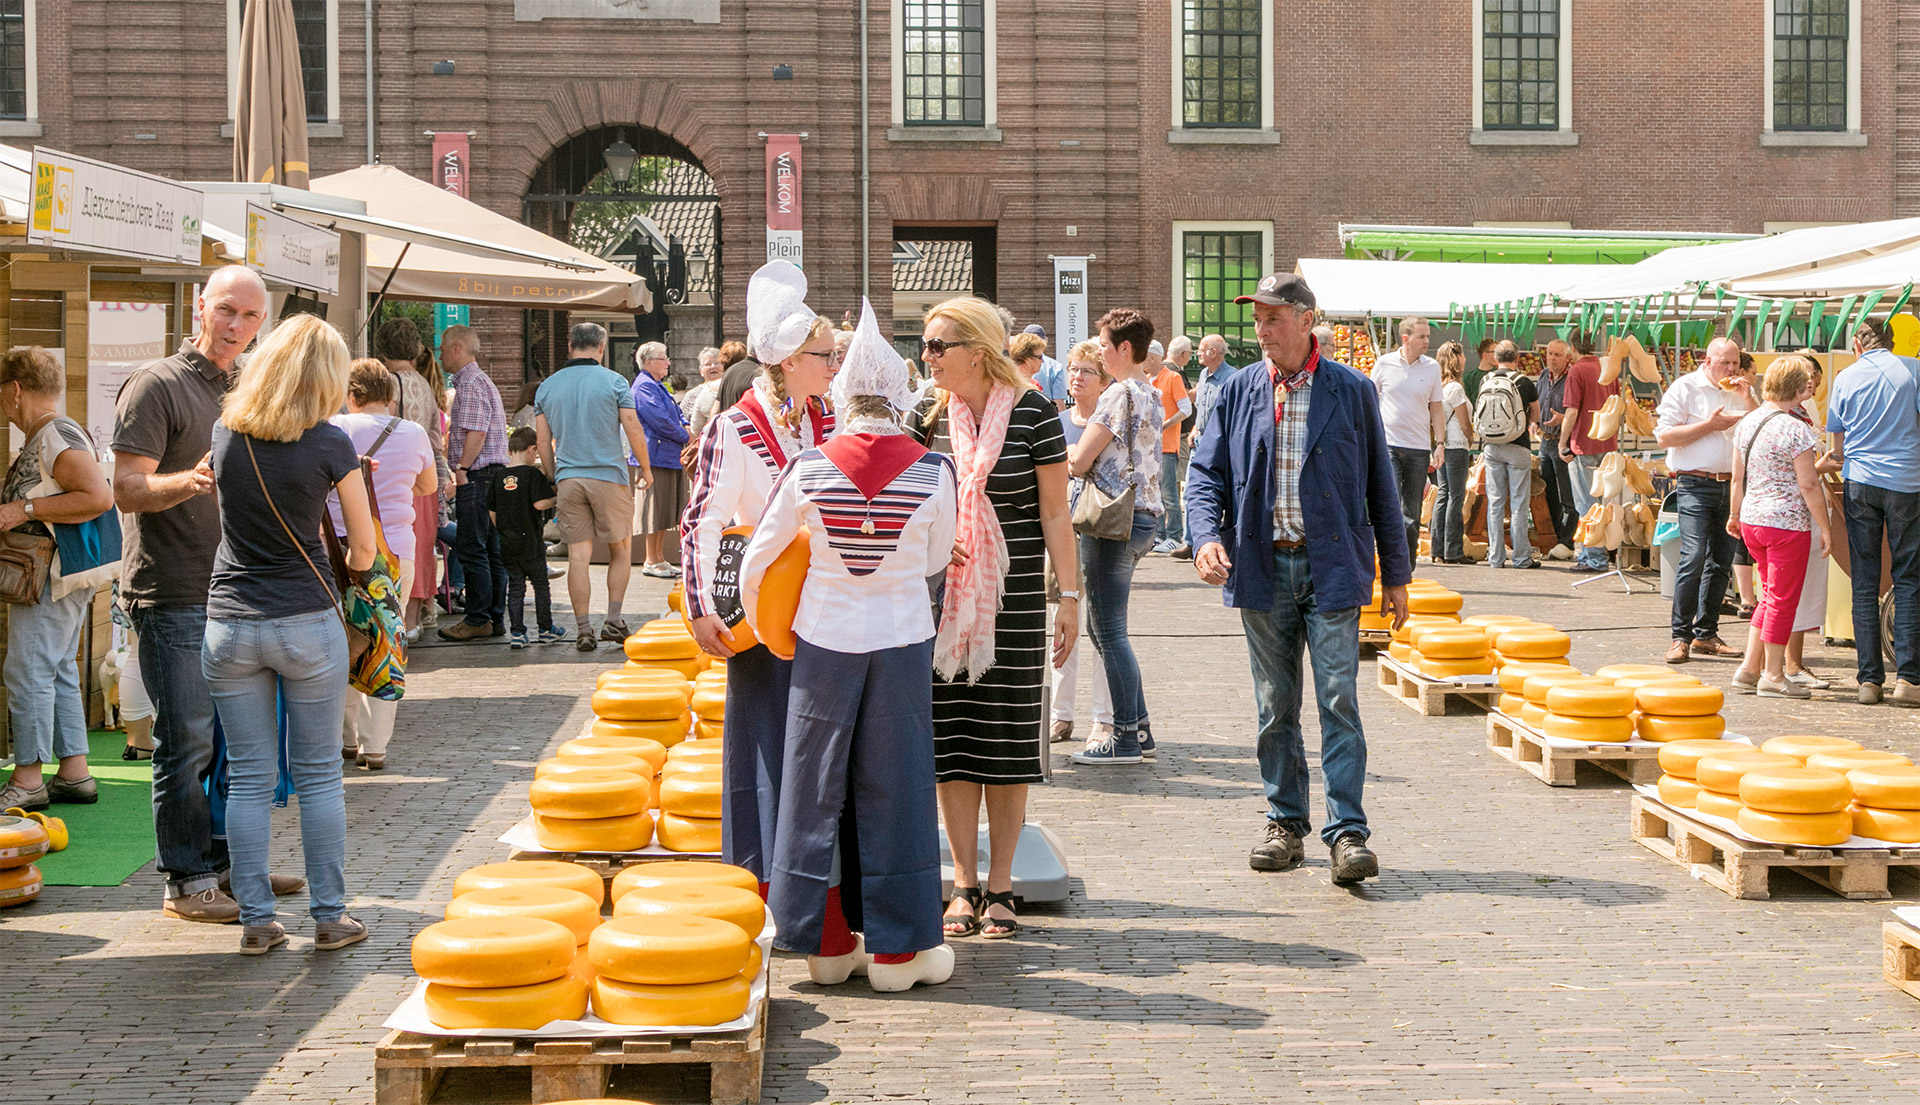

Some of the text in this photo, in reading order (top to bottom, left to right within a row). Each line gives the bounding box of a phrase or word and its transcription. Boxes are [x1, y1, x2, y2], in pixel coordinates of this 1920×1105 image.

[777, 151, 791, 214] WELKOM
[81, 186, 174, 232] Alexanderhoeve Kaas
[768, 241, 801, 257] Plein
[474, 280, 499, 296] bij
